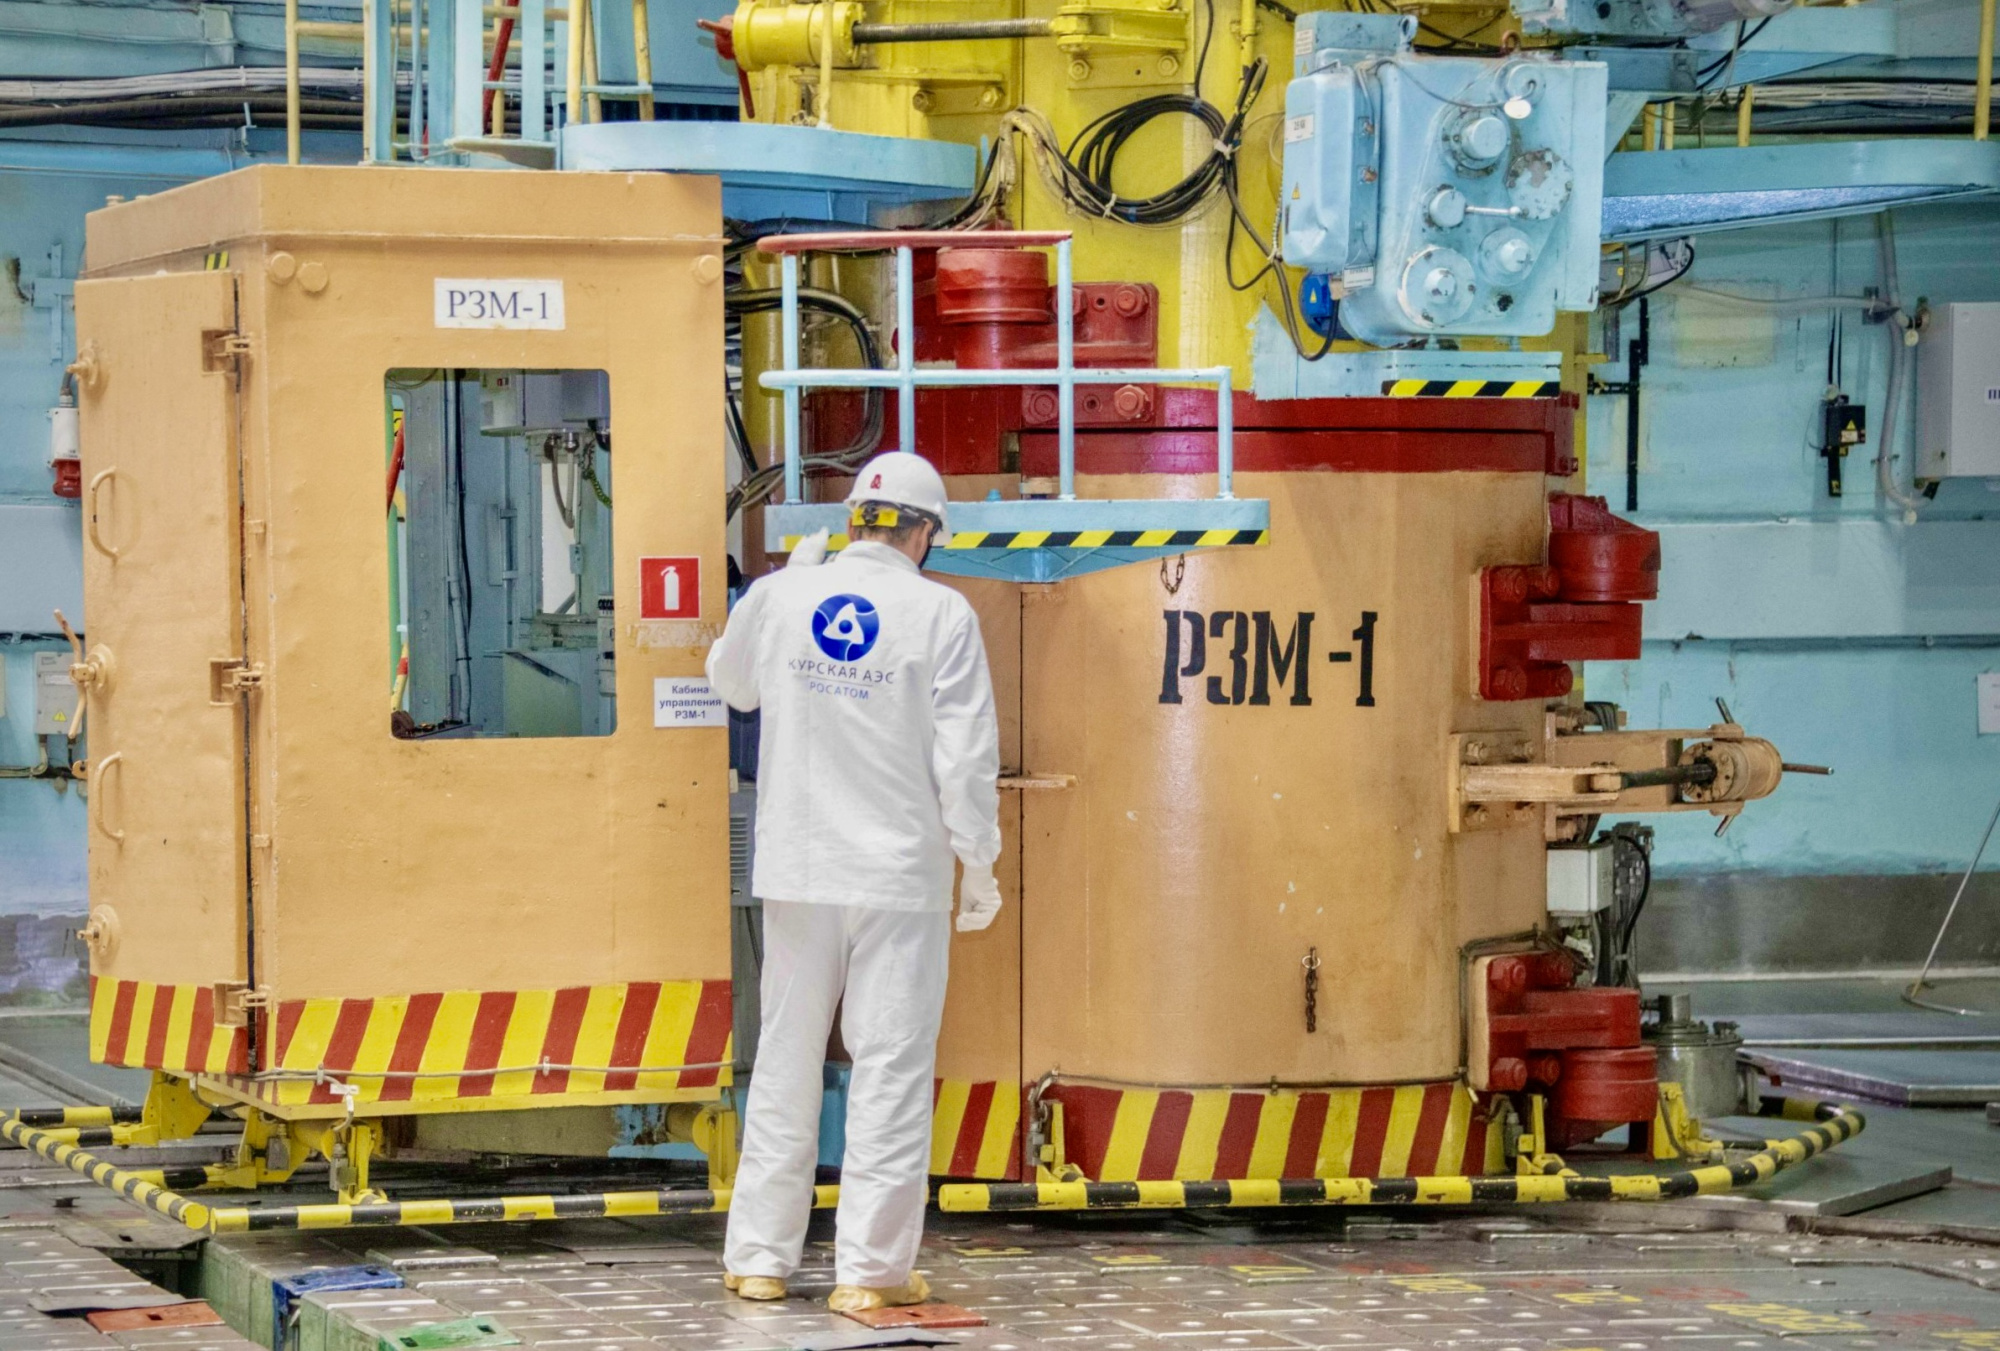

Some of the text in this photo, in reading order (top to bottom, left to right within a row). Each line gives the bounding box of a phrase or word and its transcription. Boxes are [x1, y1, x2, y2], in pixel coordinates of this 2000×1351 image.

[446, 289, 549, 320] РЗМ-1
[1158, 609, 1379, 707] РЗМ-1
[788, 658, 895, 685] КУРСКАЯ АЭС
[672, 685, 709, 694] Кабина
[809, 681, 869, 700] РОСАТОМ
[659, 699, 721, 709] управления
[675, 710, 706, 719] РЗМ-1
